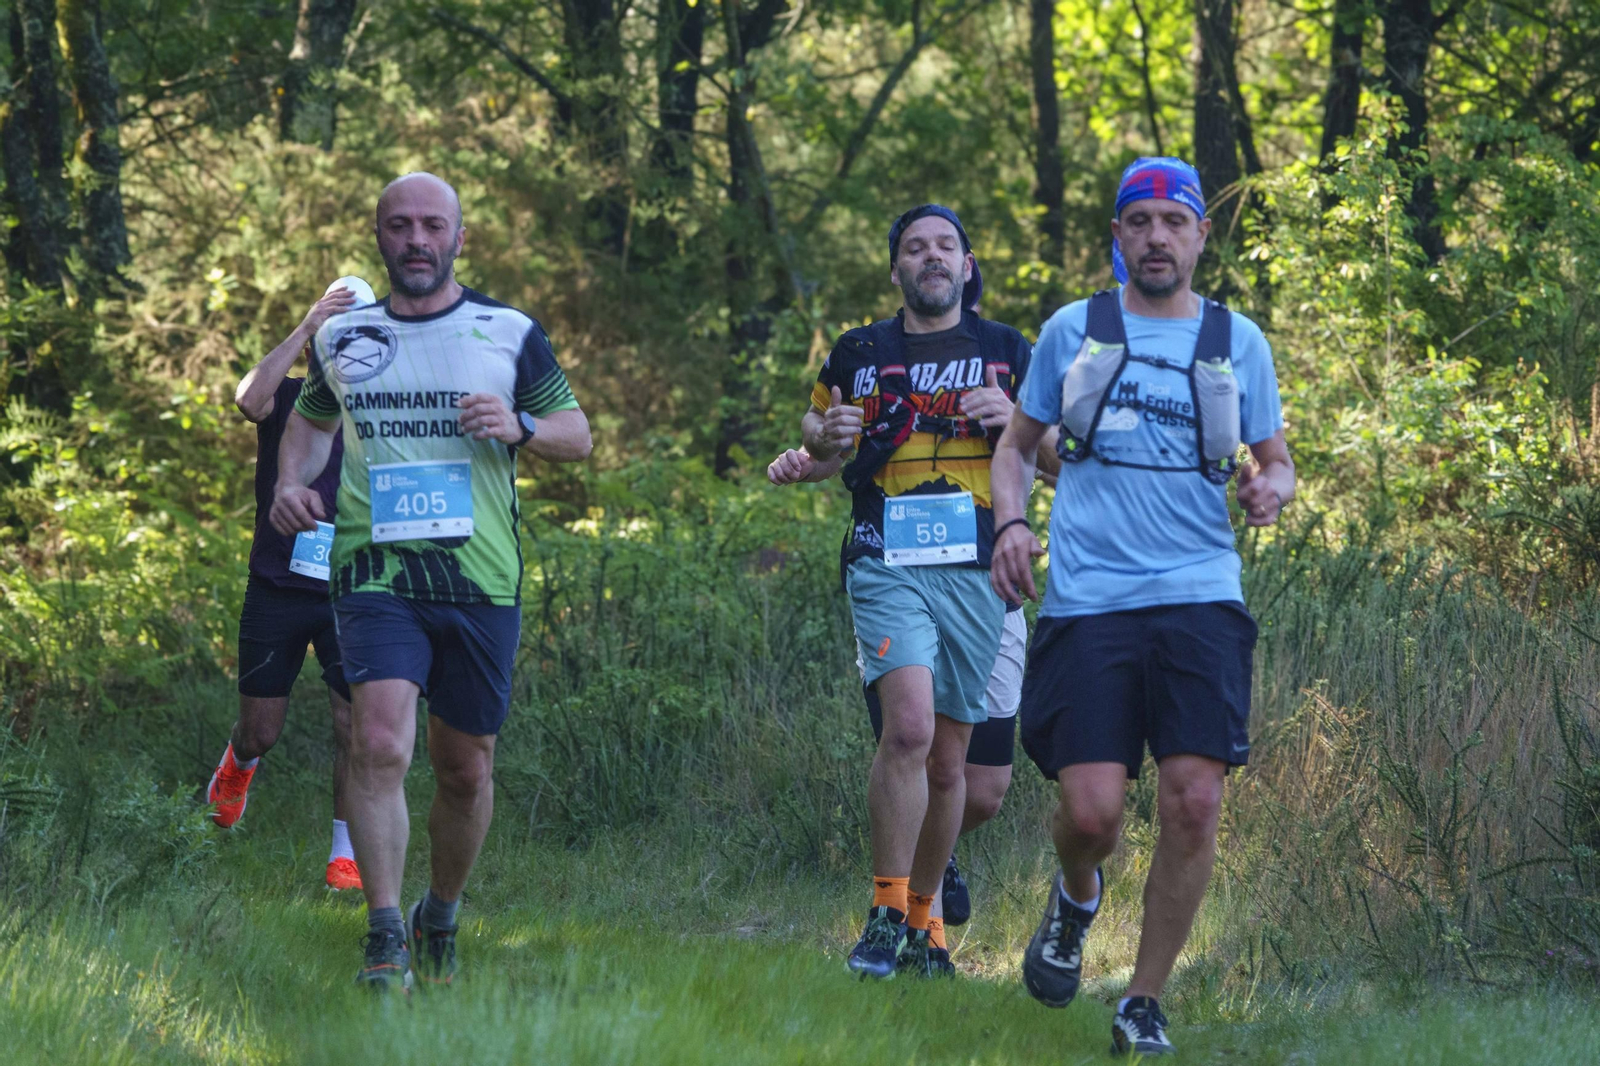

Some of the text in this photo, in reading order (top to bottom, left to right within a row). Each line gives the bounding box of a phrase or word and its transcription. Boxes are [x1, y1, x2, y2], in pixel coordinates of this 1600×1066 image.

[853, 365, 877, 399] OS
[1147, 382, 1171, 395] Trail
[1146, 394, 1191, 413] Entre
[354, 421, 375, 440] DO
[394, 491, 447, 517] 405
[916, 522, 947, 544] 59
